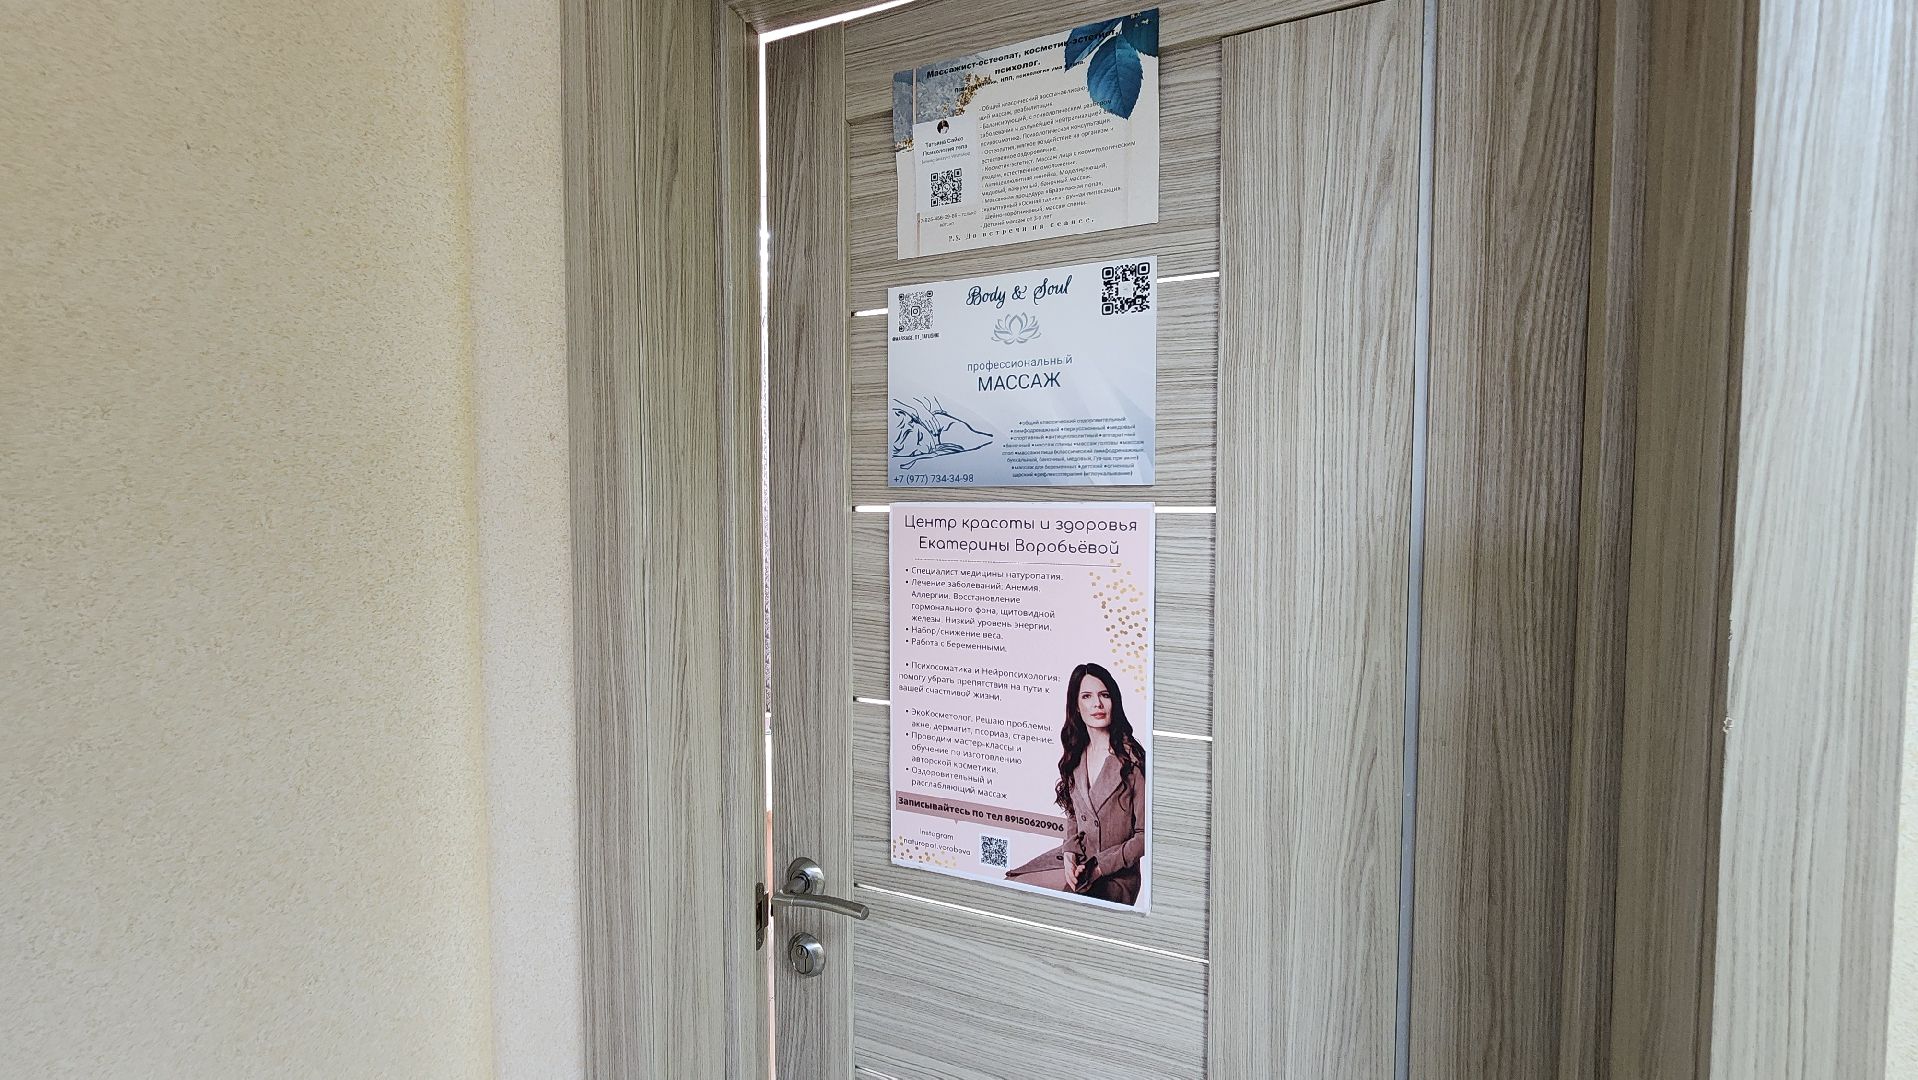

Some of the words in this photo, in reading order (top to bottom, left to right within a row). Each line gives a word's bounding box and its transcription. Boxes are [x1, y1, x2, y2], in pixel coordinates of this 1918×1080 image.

[994, 58, 1040, 75] психолог.
[965, 283, 1006, 309] Body
[1011, 283, 1027, 301] &
[1033, 274, 1072, 305] Soul
[966, 353, 1072, 374] профессиональный
[977, 370, 1061, 392] МАССАЖ
[893, 474, 903, 483] +7
[906, 473, 928, 485] (977)
[930, 473, 973, 483] 734-34-98
[904, 514, 957, 531] Центр
[961, 517, 1034, 532] красоты
[1040, 519, 1050, 530] и
[1055, 519, 1137, 535] здоровья
[919, 535, 1009, 554] Екатерины
[1014, 537, 1119, 558] Воробьёвой
[911, 566, 958, 577] Специалист
[911, 578, 945, 587] Лечение
[953, 592, 1020, 604] Восстановление
[911, 603, 972, 615] гормонального
[1000, 606, 1055, 619] щитовидной
[945, 615, 974, 625] Низкий
[976, 619, 1012, 629] уровень
[911, 637, 938, 647] Работа
[911, 661, 972, 674] Психосоматика
[898, 672, 925, 683] помогу
[927, 674, 954, 685] убрать
[1010, 683, 1020, 691] на
[1022, 684, 1042, 694] пути
[898, 683, 923, 693] вашей
[925, 685, 970, 698] счастливой
[975, 714, 1004, 726] Решаю
[911, 731, 951, 744] Проводим
[954, 736, 1013, 752] мастер-классы
[911, 743, 948, 756] обучение
[962, 749, 1022, 765] изготовлению
[911, 754, 951, 768] авторской
[911, 766, 984, 784] Оздоровительный
[986, 777, 992, 785] и
[977, 788, 1007, 800] массаж
[898, 796, 970, 816] Записывайтесь
[971, 808, 983, 818] по
[986, 811, 1003, 822] тел
[1004, 813, 1064, 832] 89150620906
